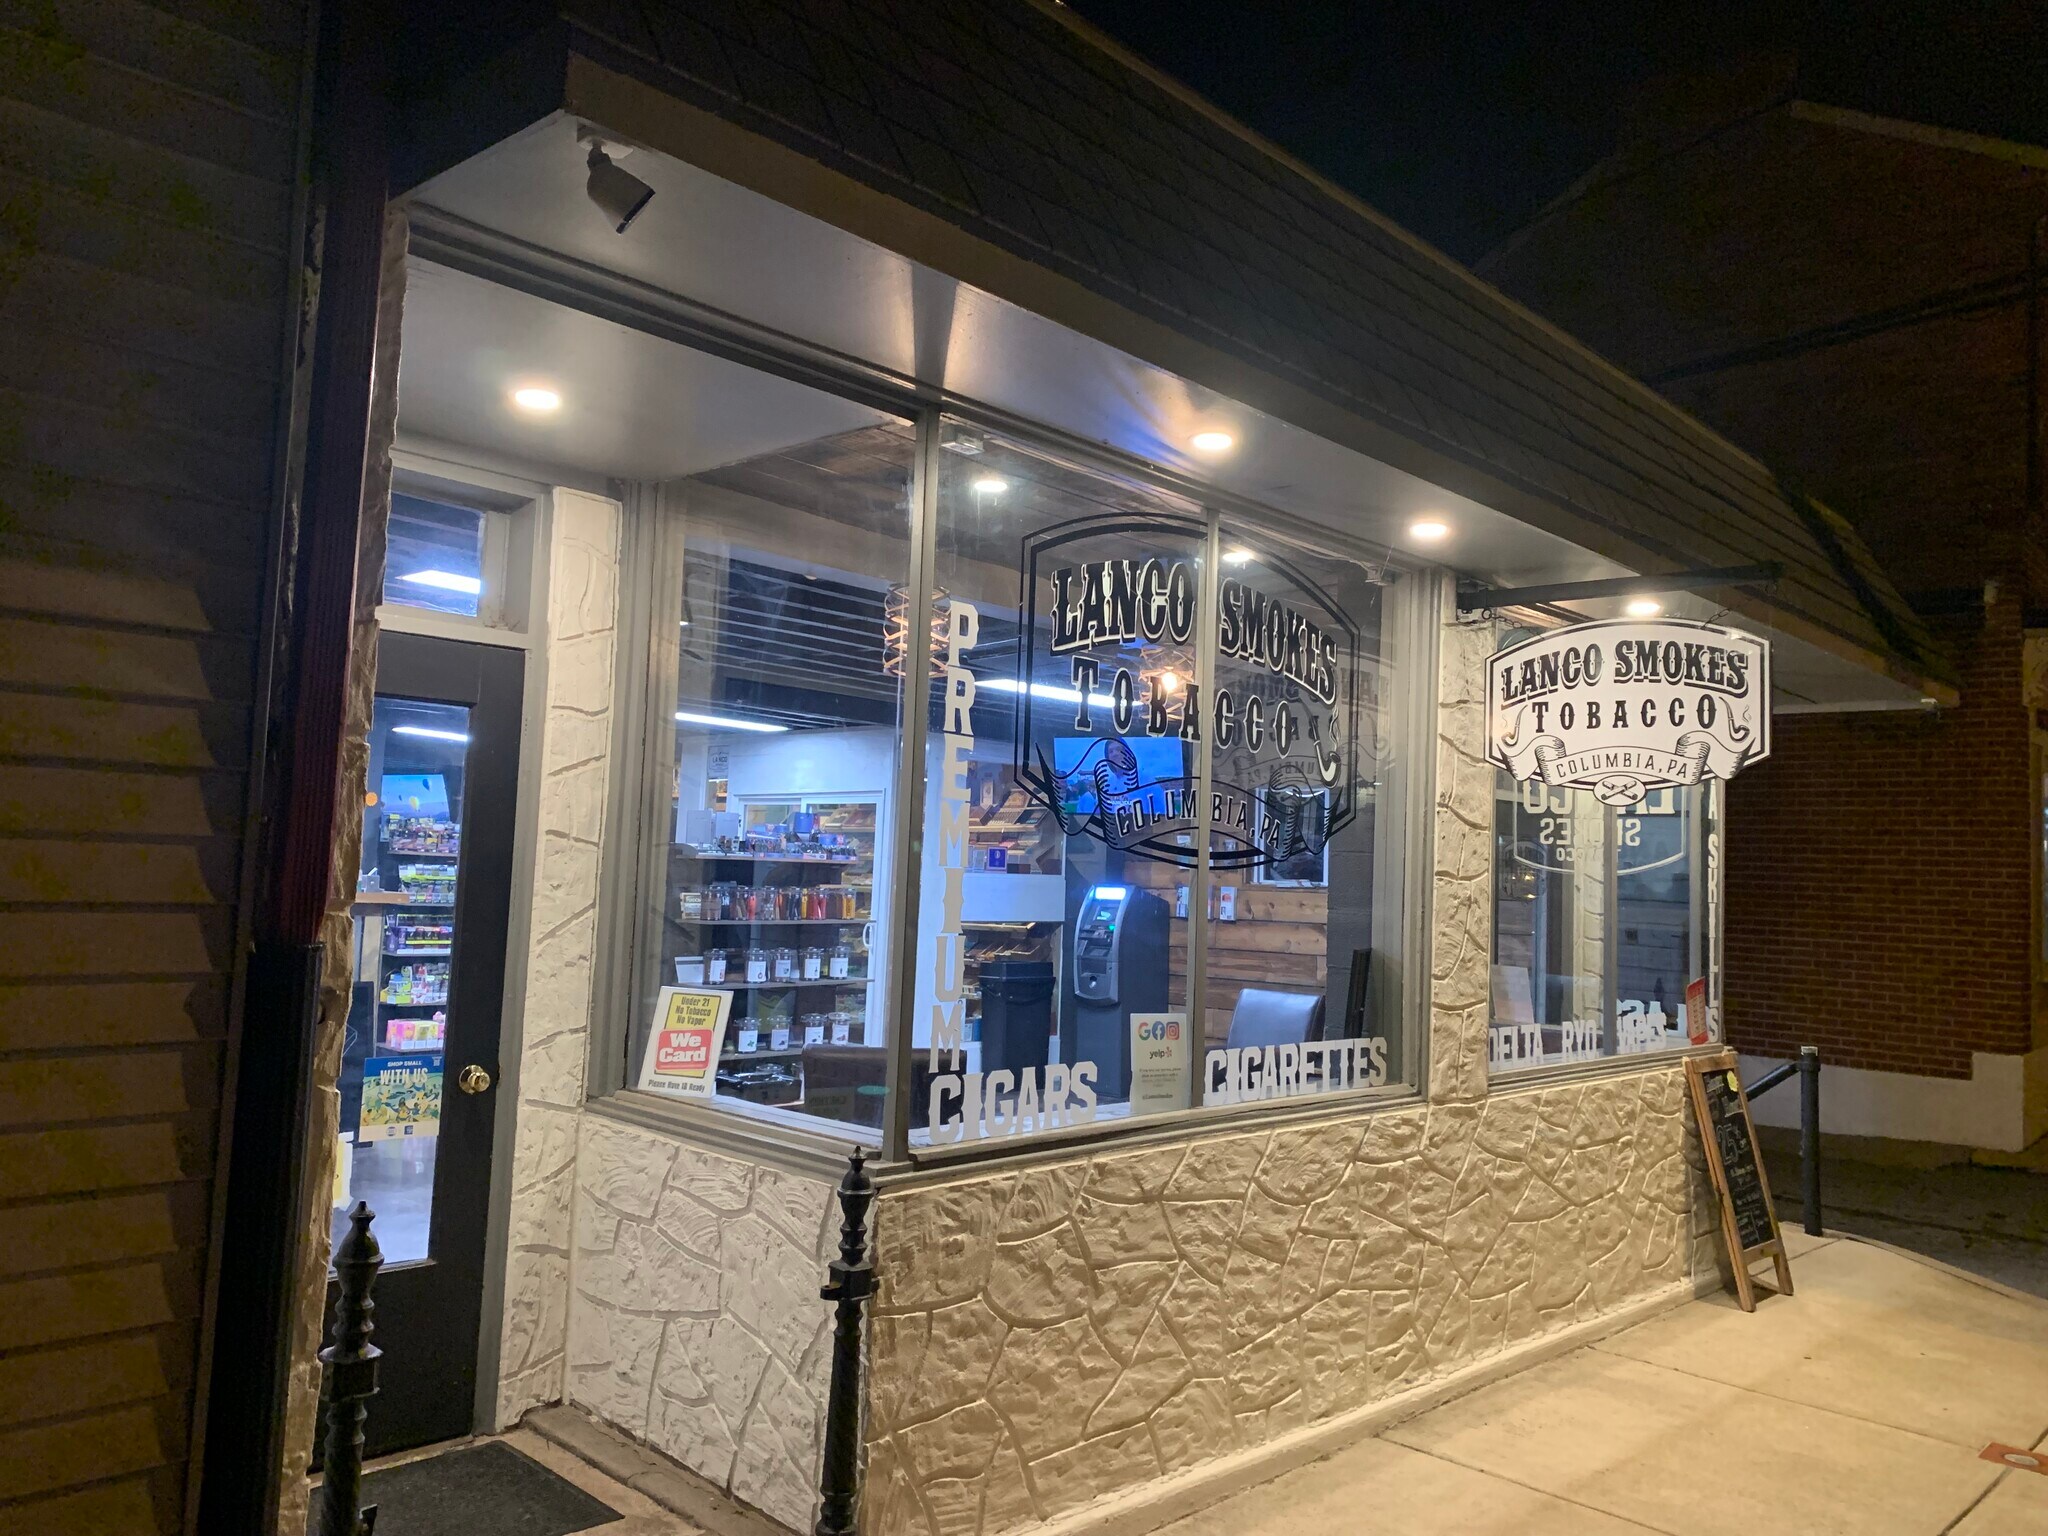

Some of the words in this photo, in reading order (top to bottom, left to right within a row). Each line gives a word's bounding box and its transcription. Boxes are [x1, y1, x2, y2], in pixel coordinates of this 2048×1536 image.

[1051, 558, 1195, 655] LANCO
[1219, 577, 1337, 706] SMOKES
[1501, 644, 1603, 709] LANCO
[1614, 640, 1748, 698] SMOKES
[1072, 656, 1293, 759] TOBACCO
[1532, 694, 1717, 733] TOBACCO
[930, 600, 979, 1073] PREMIUM
[1707, 833, 1719, 1043] SKILLS
[675, 1006, 684, 1015] No
[686, 1006, 711, 1017] Tobacco
[676, 1015, 684, 1024] No
[687, 1016, 706, 1026] Vapor
[681, 997, 700, 1006] Under
[702, 998, 710, 1006] 21
[659, 1047, 706, 1063] Card
[670, 1032, 701, 1048] We
[1150, 1048, 1165, 1059] yelp
[1489, 1023, 1544, 1066] DELTA
[1562, 1020, 1597, 1061] RYO
[380, 1068, 410, 1085] WITH
[413, 1067, 428, 1083] US
[648, 1080, 666, 1089] Please
[667, 1082, 680, 1090] Have
[689, 1083, 706, 1093] Ready
[1204, 1037, 1387, 1101] CIGARETTES
[928, 1061, 1098, 1144] CIGARS
